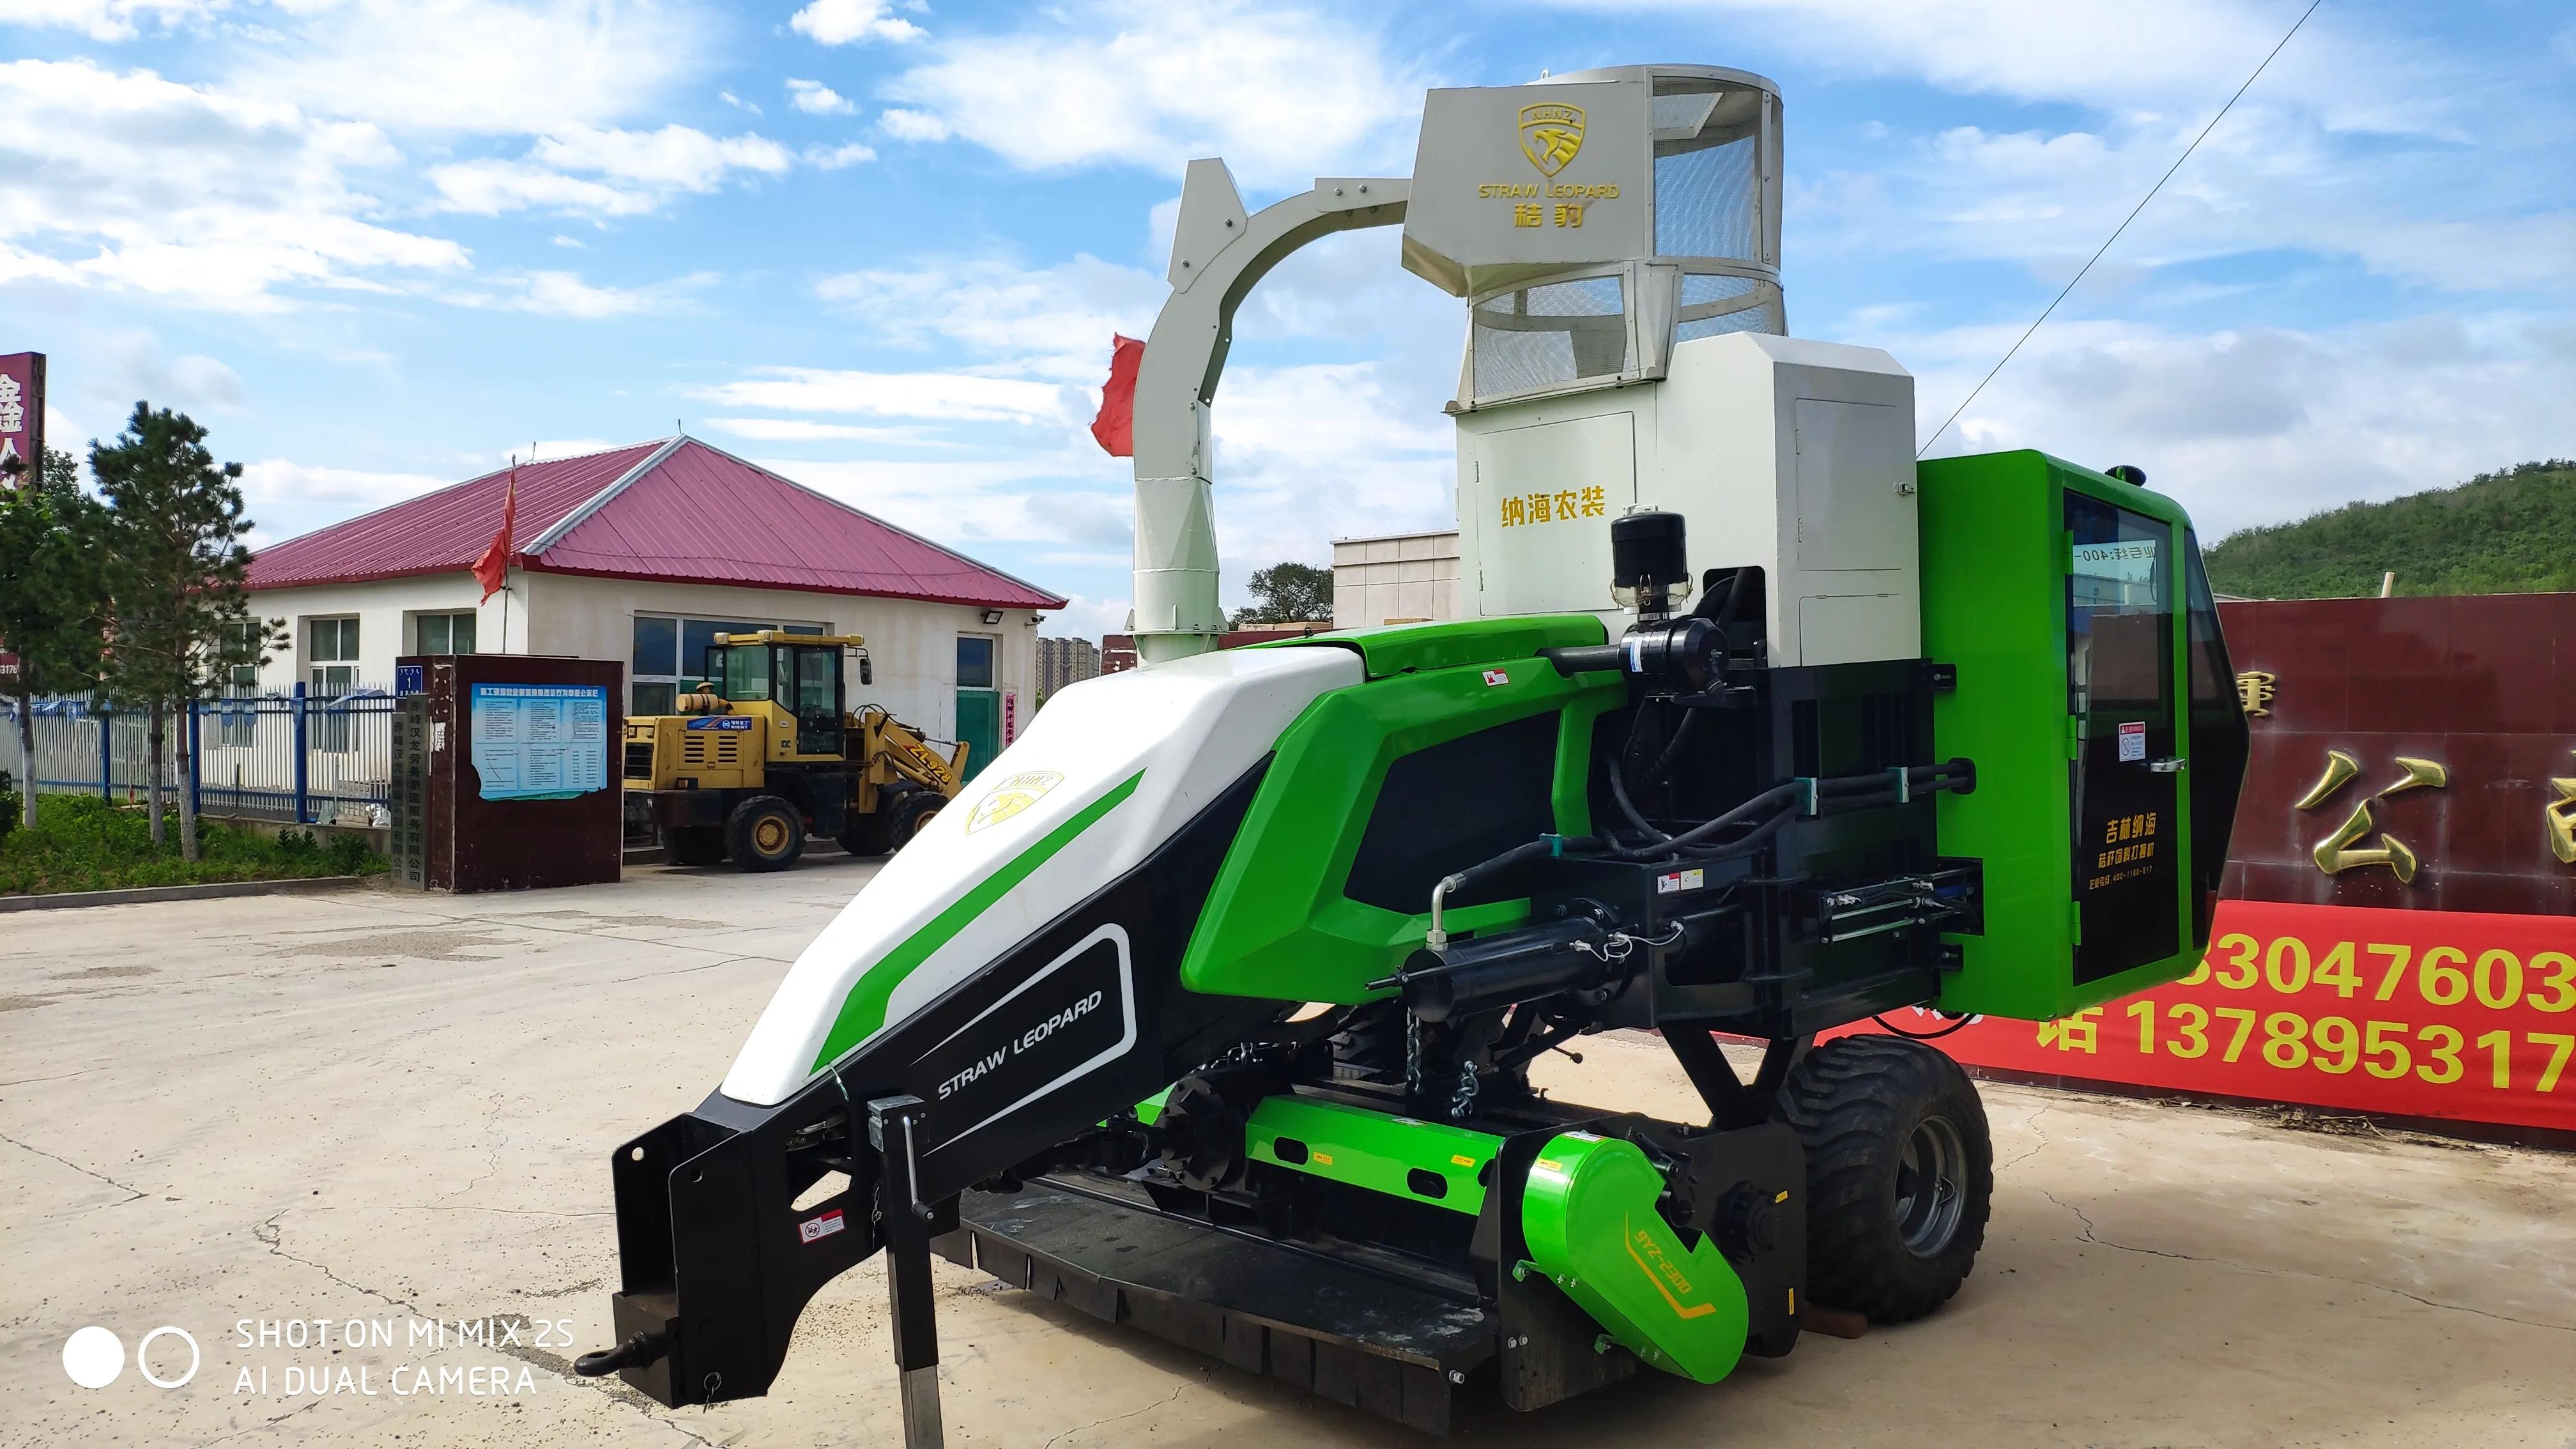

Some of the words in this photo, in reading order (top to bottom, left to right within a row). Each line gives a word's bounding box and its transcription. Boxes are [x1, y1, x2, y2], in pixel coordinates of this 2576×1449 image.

[1532, 110, 1575, 121] NHNZ
[1478, 184, 1539, 199] STRAW
[1544, 184, 1620, 199] LEOPARD
[1501, 486, 1606, 528] 纳海农装
[0, 664, 17, 674] 3176
[407, 677, 411, 689] 1
[909, 743, 953, 783] ZL928
[2106, 812, 2157, 844] 吉林纳海
[938, 1046, 1007, 1101] STRAW
[1013, 990, 1102, 1054] LEOPARD
[2127, 1000, 2575, 1092] 137895317
